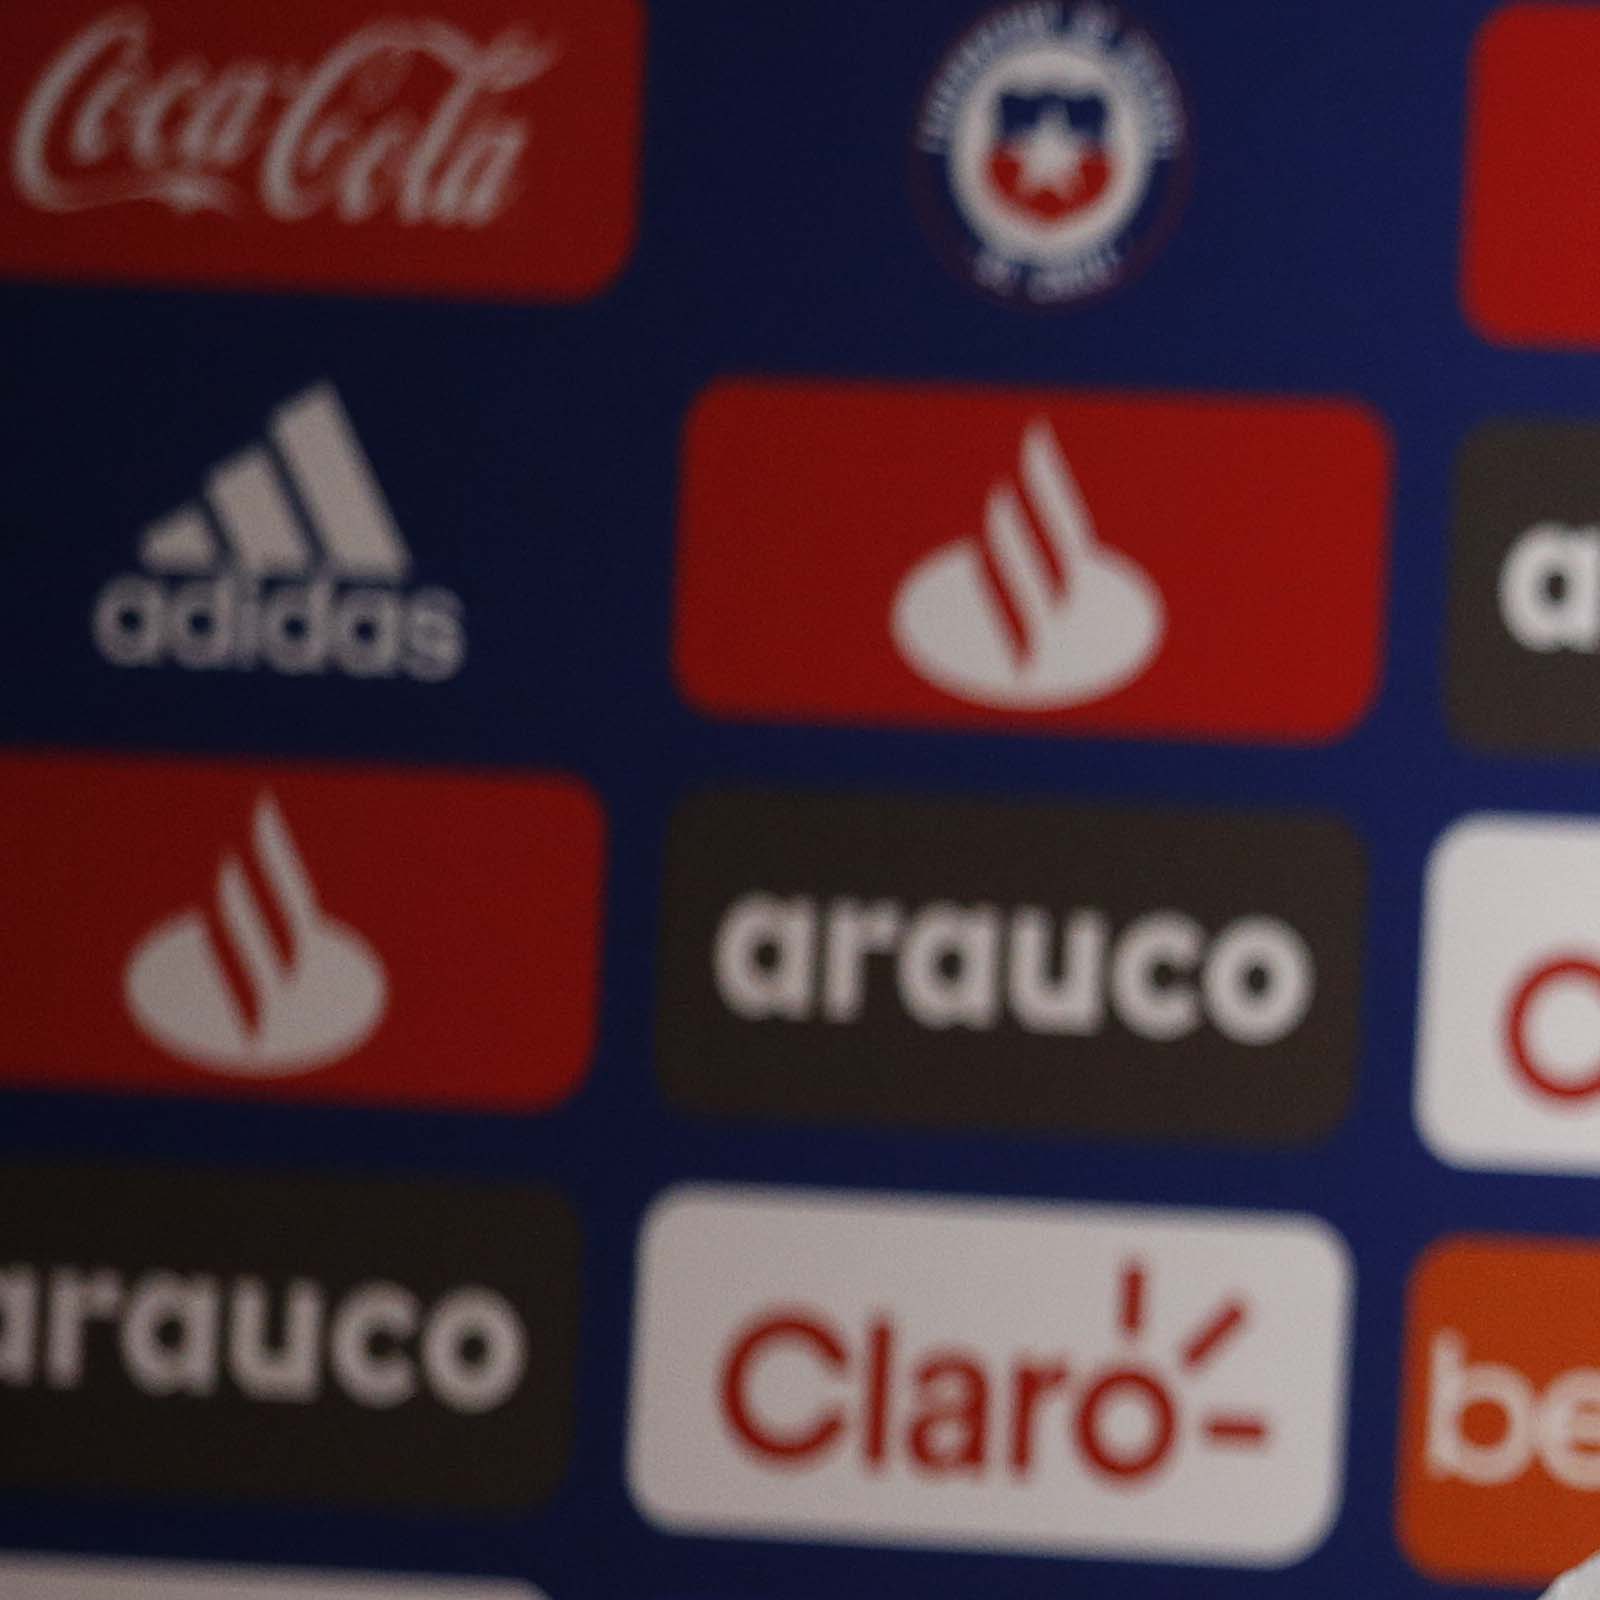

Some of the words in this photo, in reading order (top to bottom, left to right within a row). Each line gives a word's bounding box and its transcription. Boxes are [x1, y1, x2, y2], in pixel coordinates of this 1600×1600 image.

[92, 566, 468, 683] adidas
[711, 890, 1317, 1048] arauco
[719, 1305, 1177, 1484] Claro
